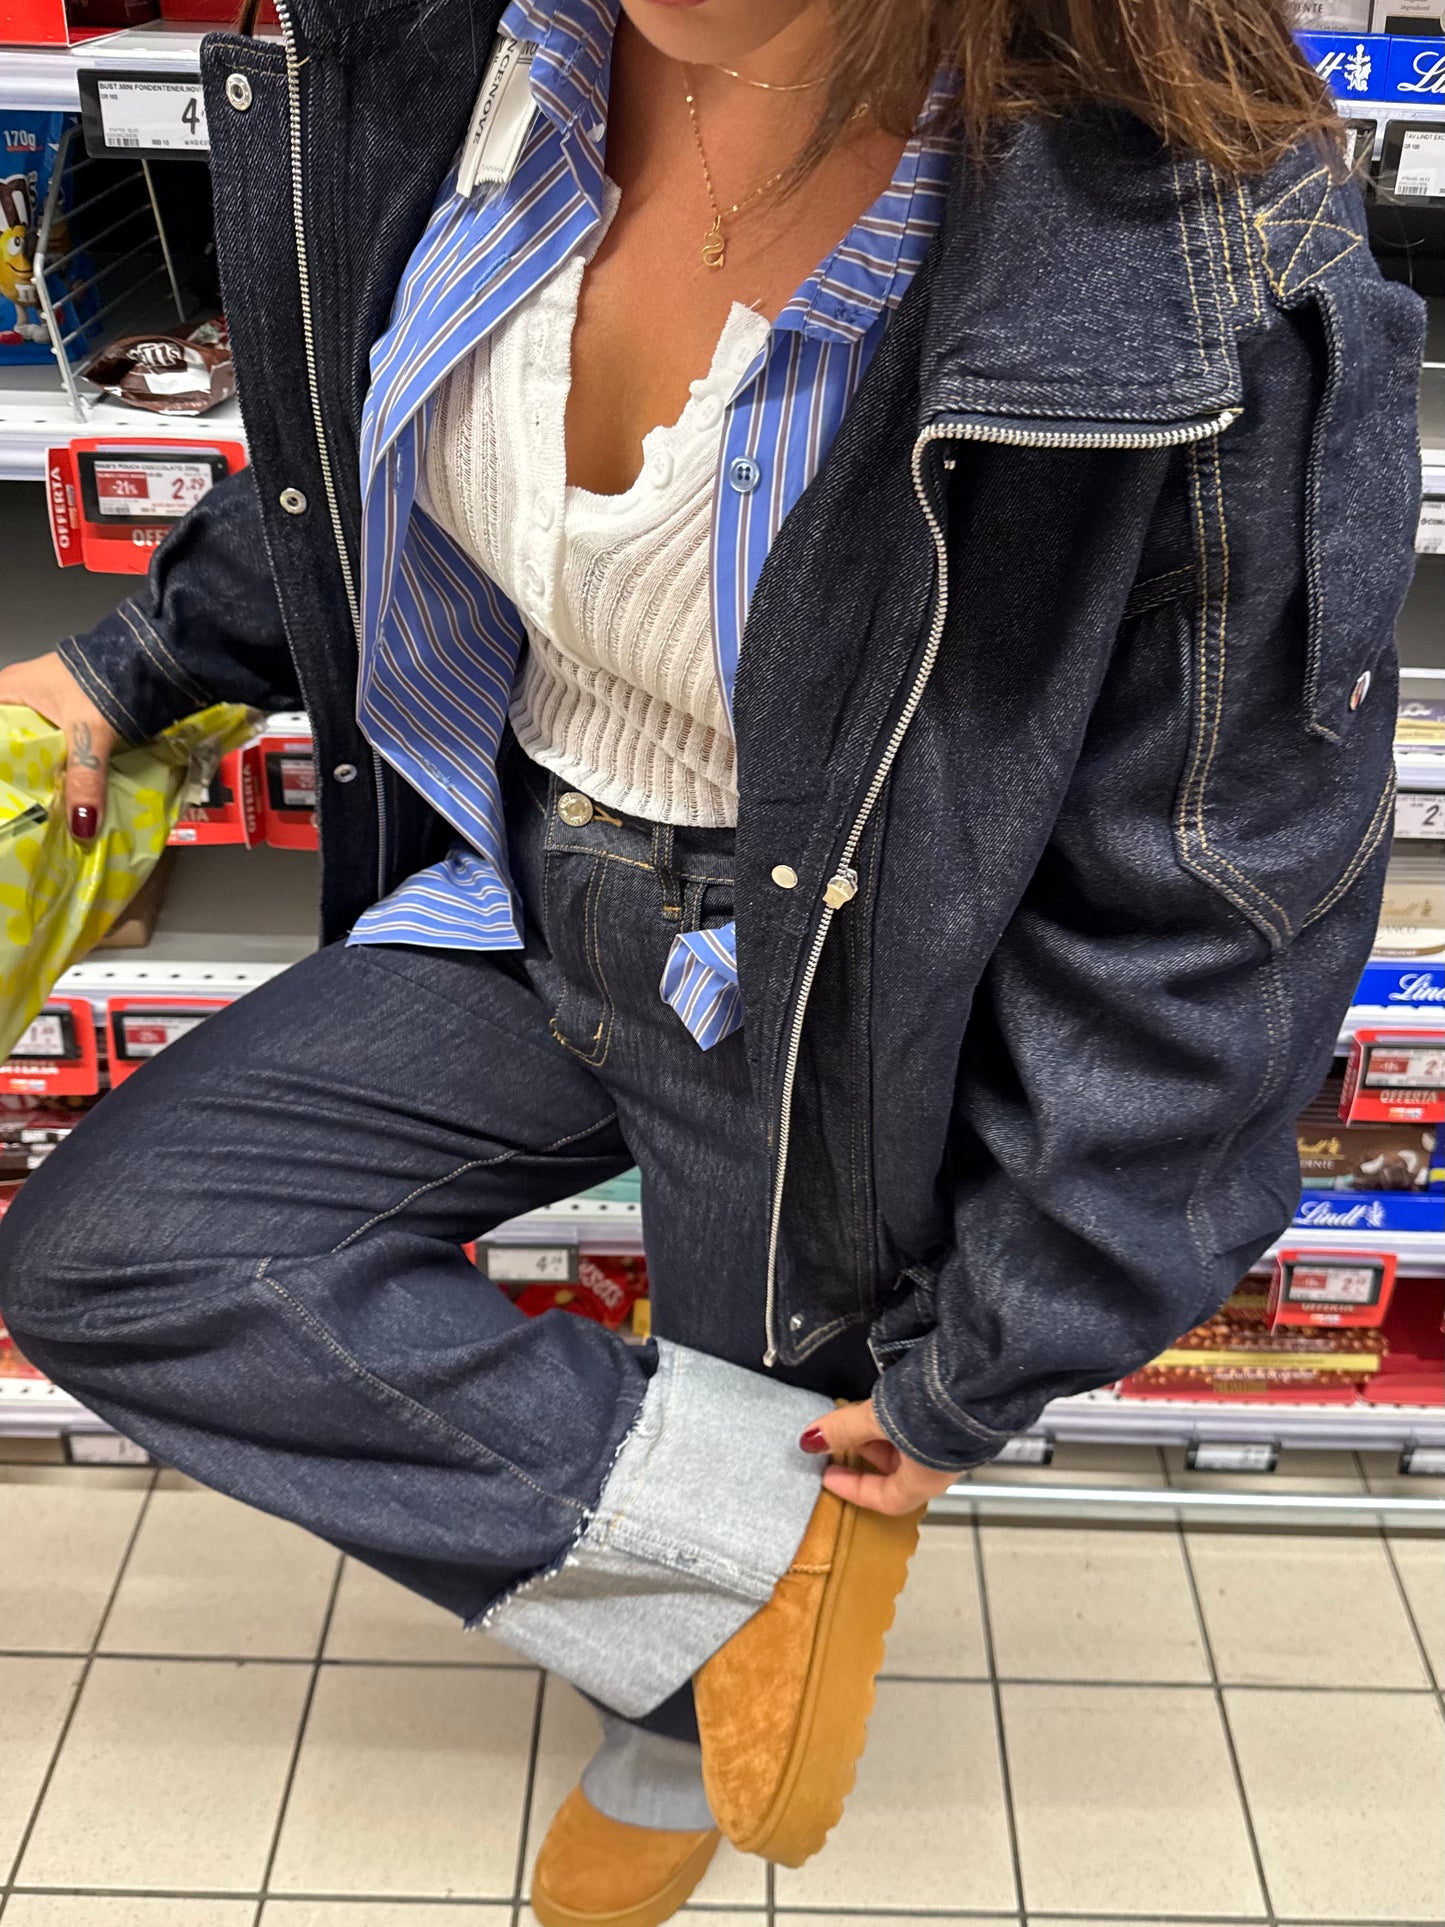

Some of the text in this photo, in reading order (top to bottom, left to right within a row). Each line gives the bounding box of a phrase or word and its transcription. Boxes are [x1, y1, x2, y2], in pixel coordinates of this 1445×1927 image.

[3, 130, 37, 152] 170g
[51, 467, 71, 549] OFFERTA
[1379, 1089, 1438, 1104] OFFERTA
[1292, 1200, 1366, 1227] Lindt
